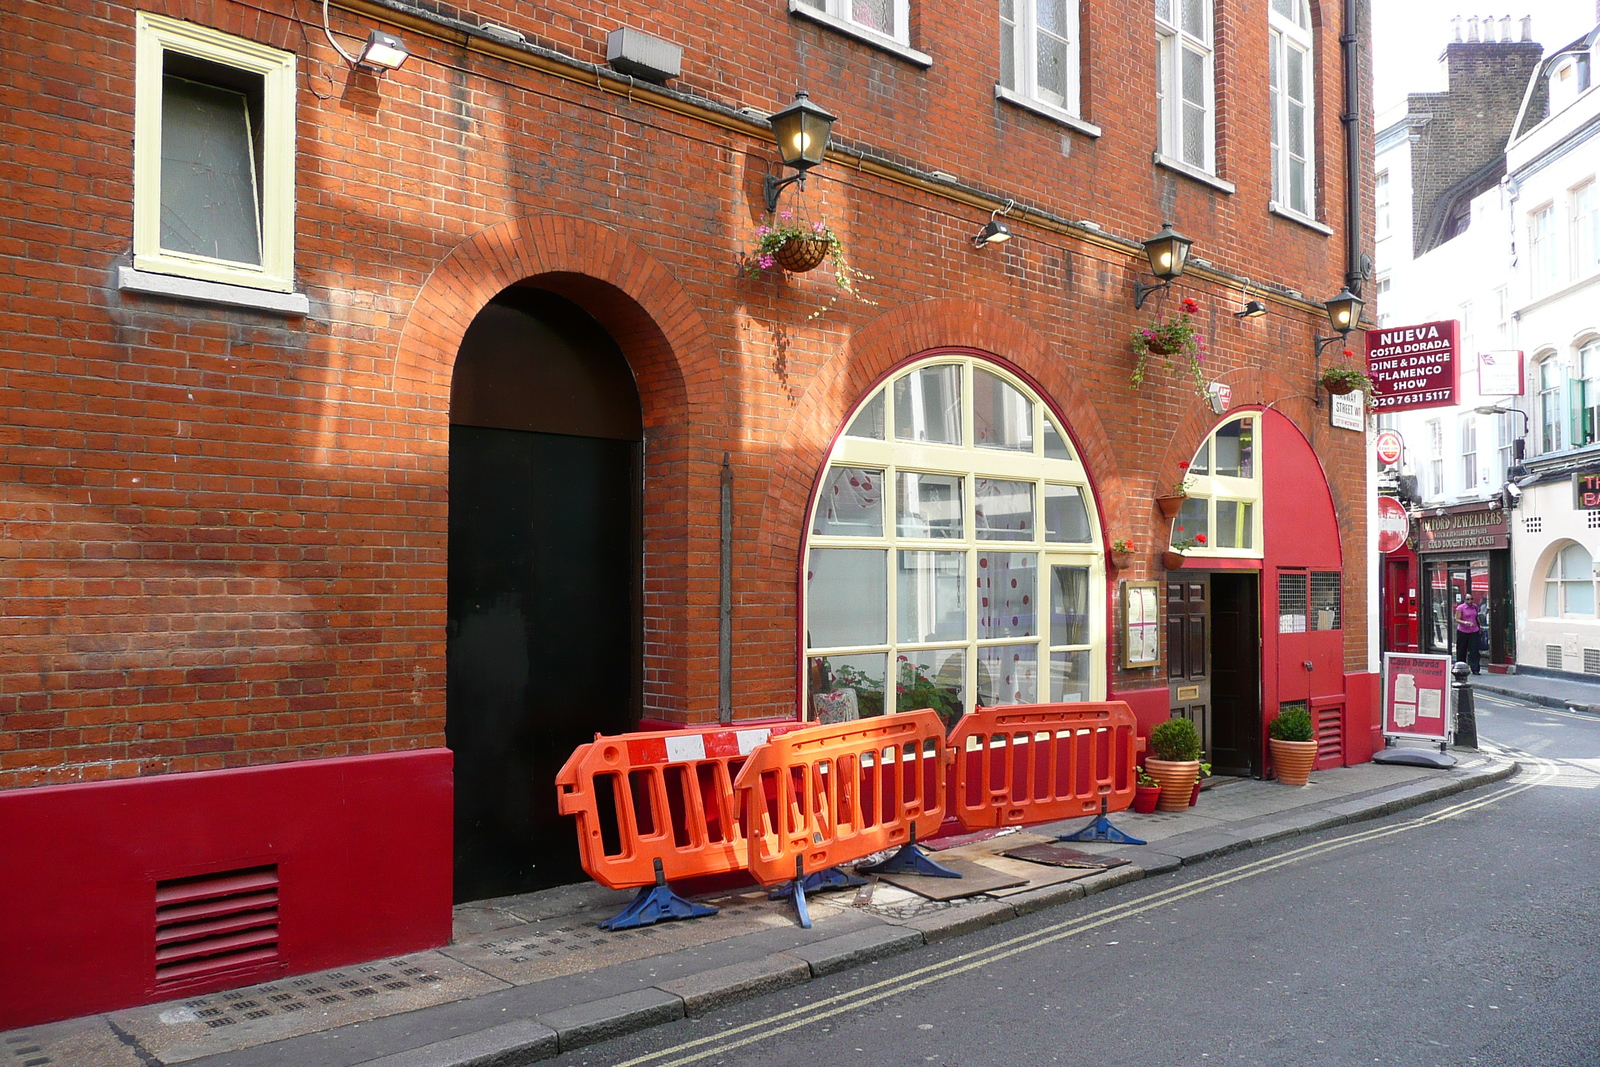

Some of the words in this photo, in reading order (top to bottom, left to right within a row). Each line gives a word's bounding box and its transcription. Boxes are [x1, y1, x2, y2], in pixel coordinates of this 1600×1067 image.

[1381, 326, 1439, 345] NUEVA
[1370, 346, 1402, 357] COSTA
[1404, 339, 1450, 353] DORADA
[1371, 360, 1398, 371] DINE
[1400, 359, 1408, 367] &
[1410, 353, 1450, 366] DANCE
[1379, 365, 1442, 381] FLAMENCO
[1393, 379, 1427, 390] SHOW
[1372, 398, 1394, 407] 020
[1397, 394, 1423, 404] 7631
[1425, 391, 1450, 401] 5117
[1336, 401, 1353, 415] STREET
[1422, 517, 1451, 531] OXFORD
[1453, 511, 1502, 529] JEWELLERS
[1428, 540, 1441, 549] GOLD
[1443, 538, 1464, 548] BOUGHT
[1465, 537, 1477, 546] FOR
[1478, 536, 1495, 545] CASH
[1390, 657, 1411, 666] Costa
[1412, 658, 1440, 668] Dorada
